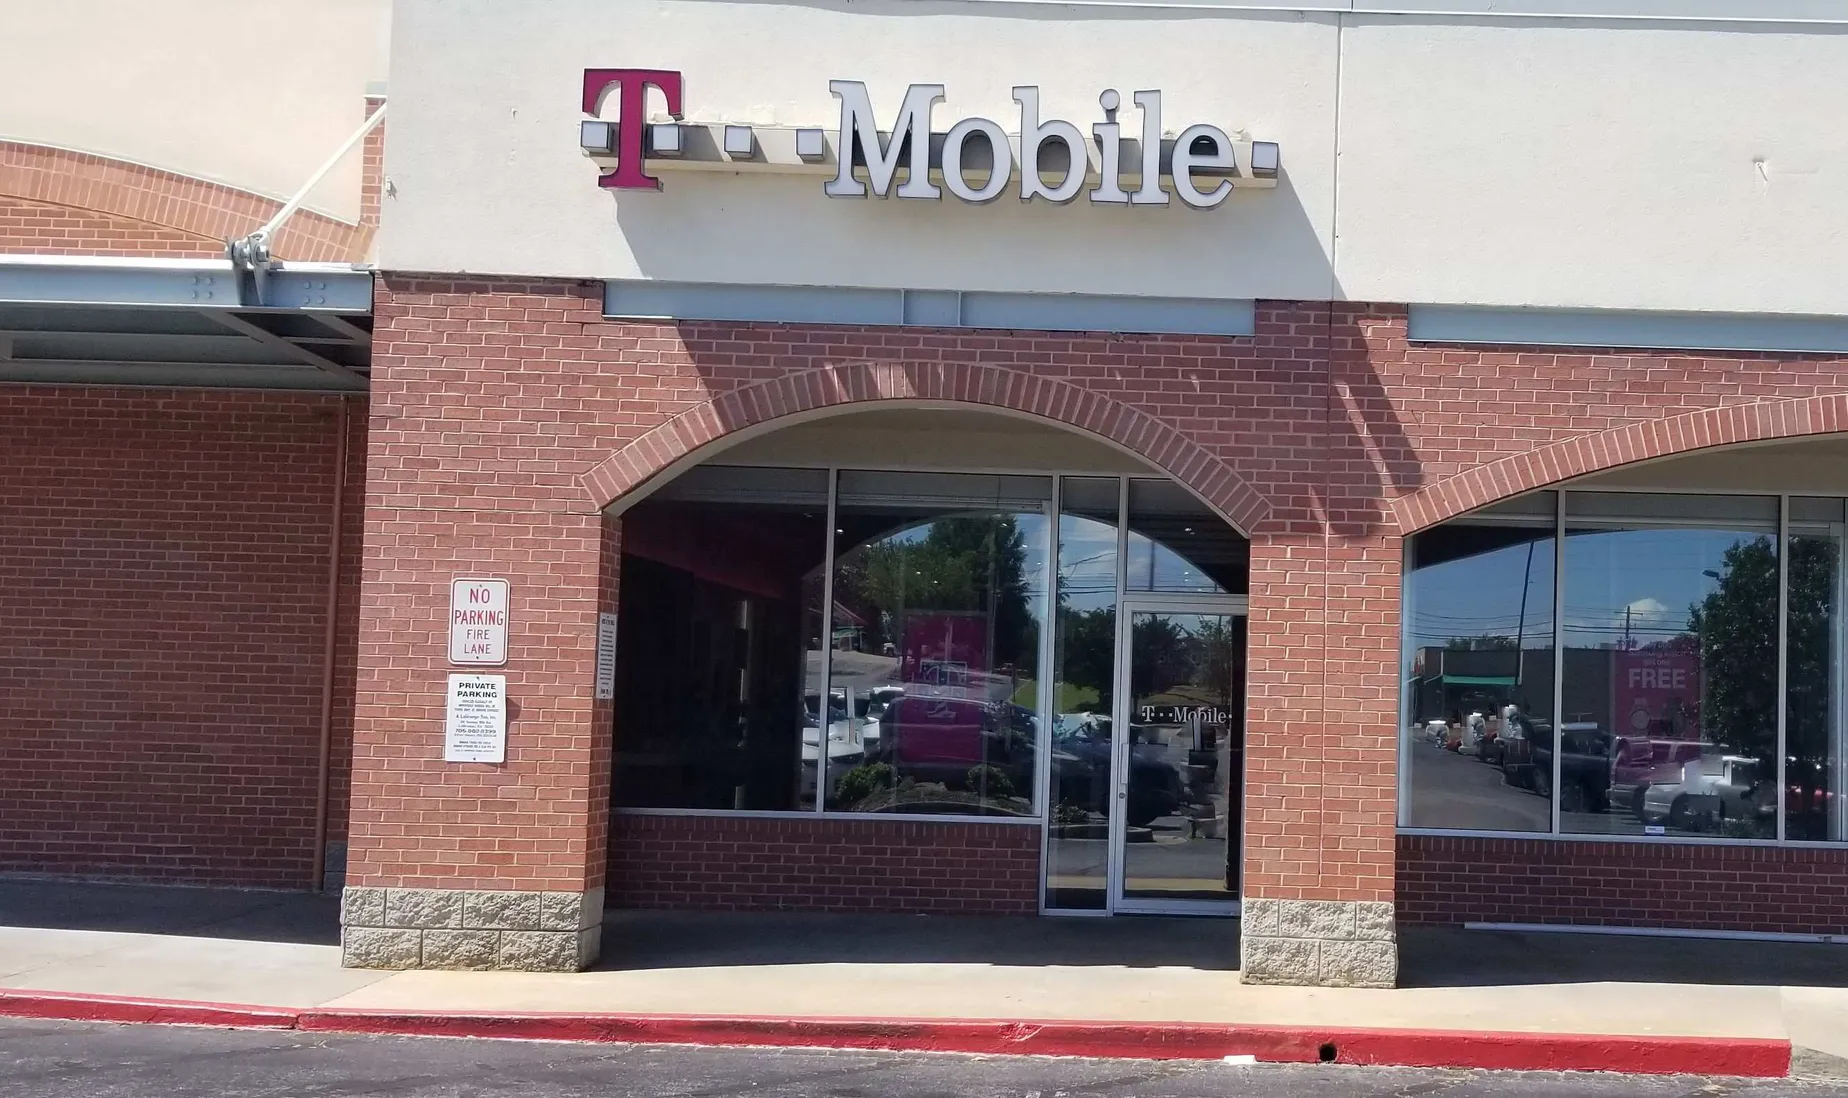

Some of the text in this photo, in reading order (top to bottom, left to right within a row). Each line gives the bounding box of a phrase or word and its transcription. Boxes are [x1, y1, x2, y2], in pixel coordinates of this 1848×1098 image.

[469, 588, 491, 604] NO
[454, 609, 504, 626] PARKING
[466, 629, 491, 640] FIRE
[464, 643, 492, 655] LANE
[1628, 668, 1687, 689] FREE
[458, 682, 497, 690] PRIVATE
[457, 690, 498, 698] PARKING
